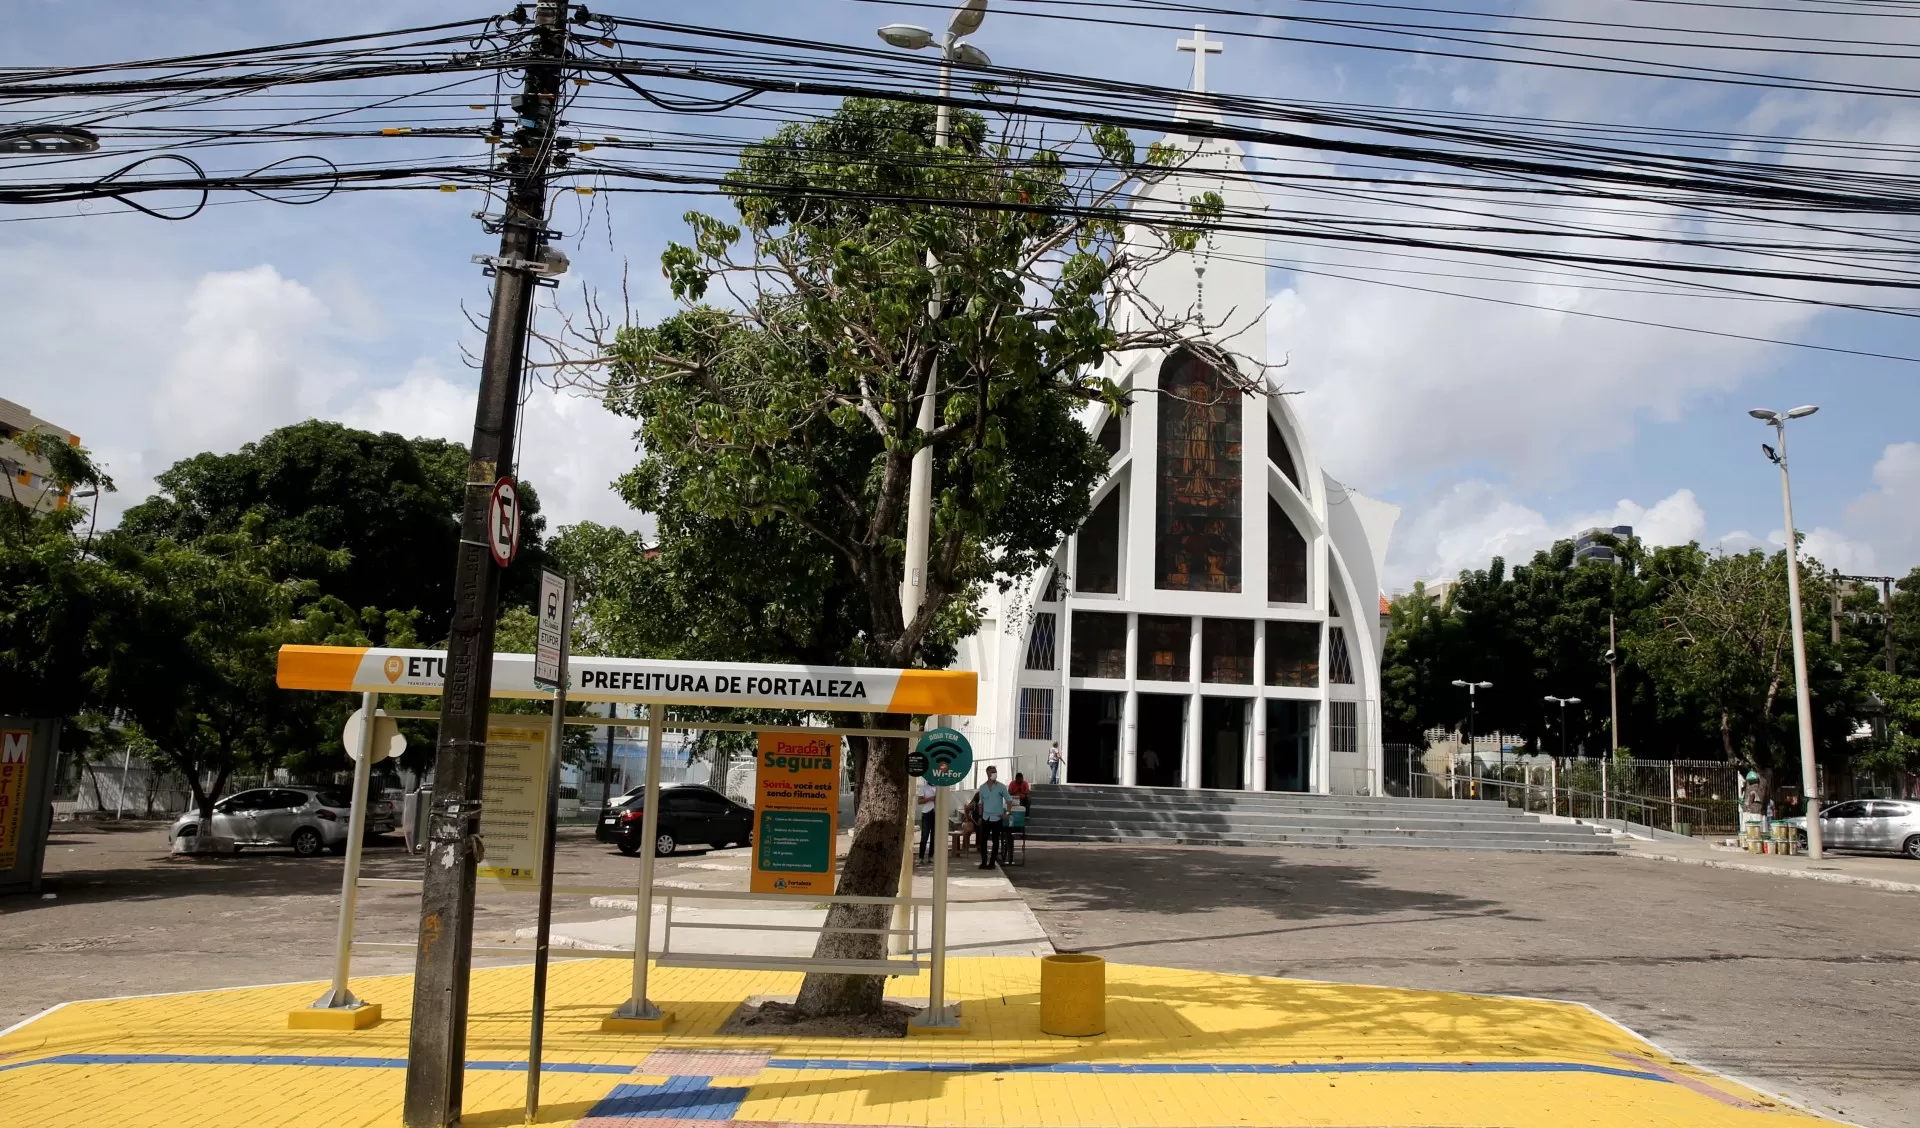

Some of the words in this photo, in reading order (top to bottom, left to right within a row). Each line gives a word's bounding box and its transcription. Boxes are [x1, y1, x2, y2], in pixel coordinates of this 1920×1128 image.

[541, 632, 559, 647] ETUFOR
[408, 656, 447, 678] ETU
[581, 670, 709, 693] PREFEITURA
[715, 676, 741, 694] DE
[747, 677, 867, 698] FORTALEZA
[928, 732, 943, 741] AQUI
[944, 732, 959, 741] TEM
[777, 741, 819, 754] Parada
[764, 752, 832, 773] Segura
[932, 769, 962, 778] Wi-For
[763, 780, 793, 790] Sorria,
[793, 781, 813, 790] você
[814, 782, 832, 791] está
[766, 790, 792, 798] sendo
[793, 790, 828, 799] filmado.
